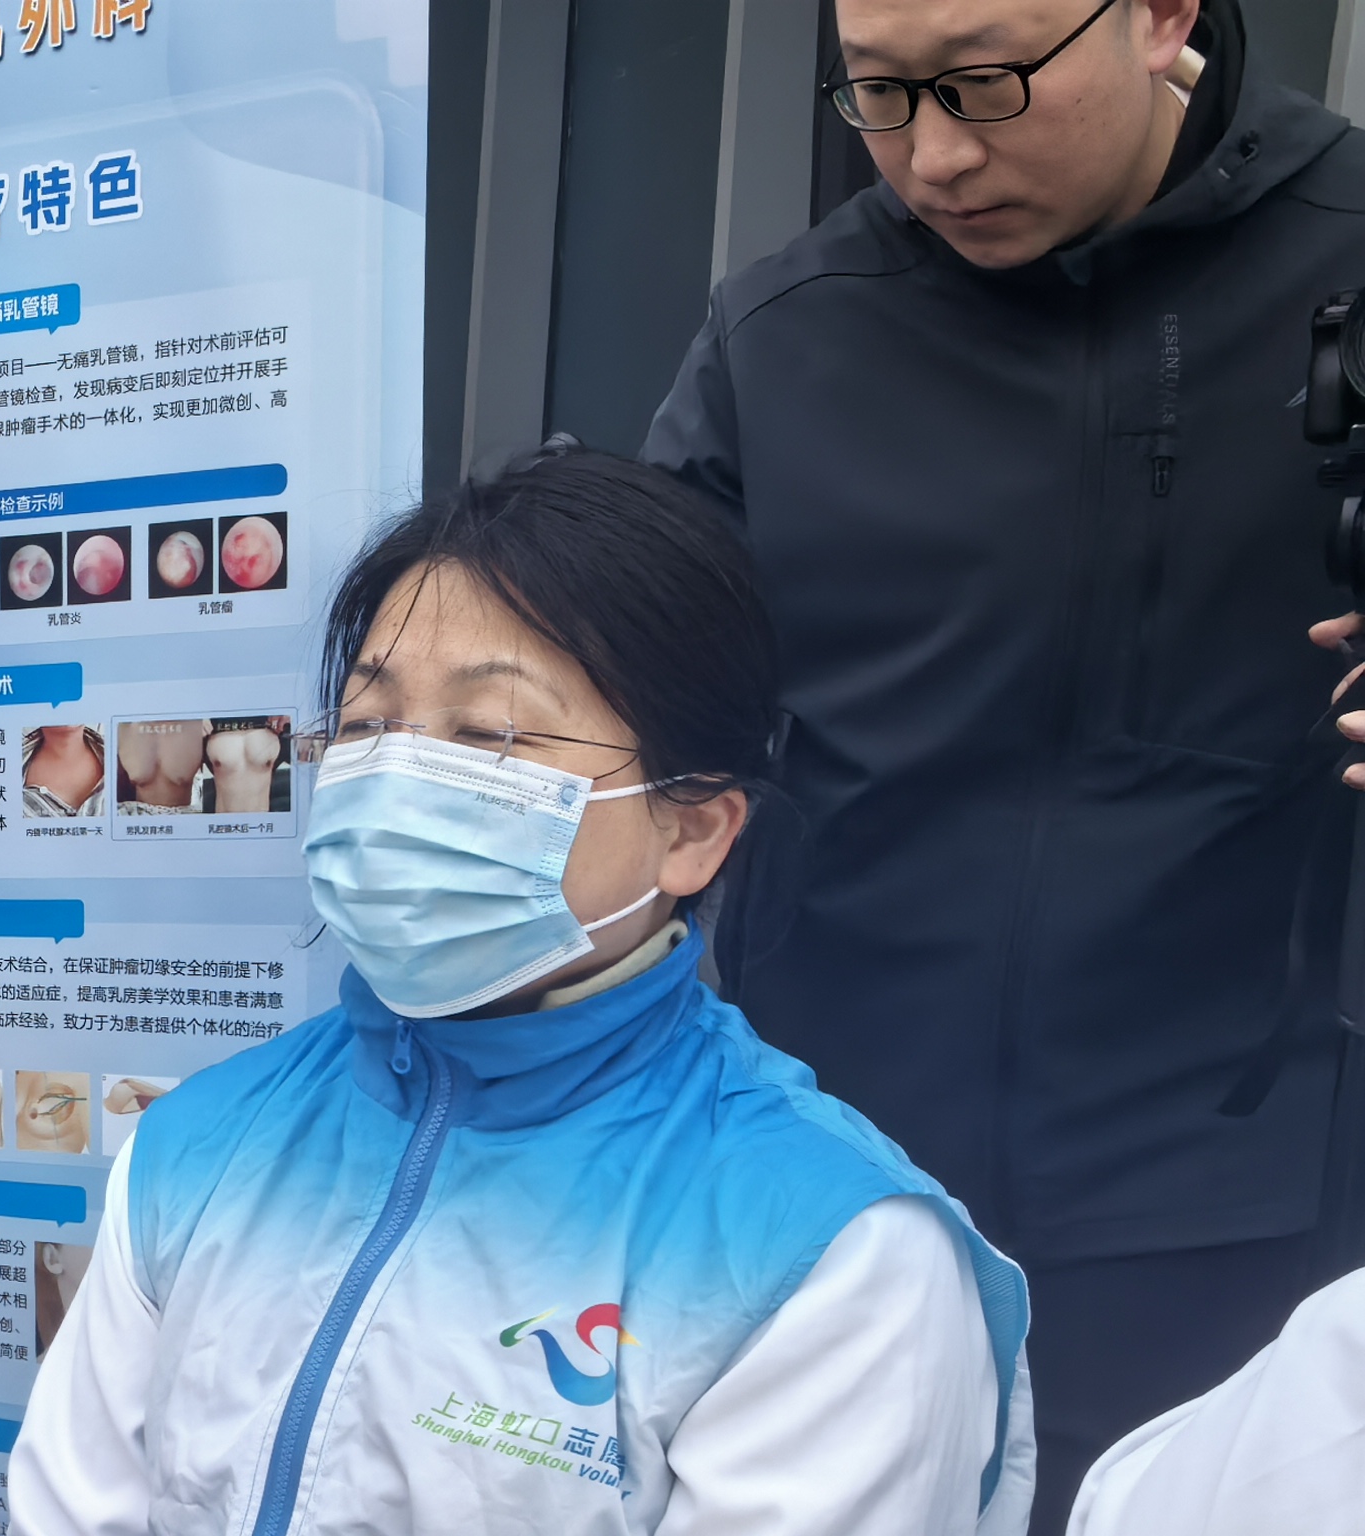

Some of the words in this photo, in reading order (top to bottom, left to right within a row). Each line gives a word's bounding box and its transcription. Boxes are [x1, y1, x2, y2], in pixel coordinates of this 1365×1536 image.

[47, 612, 82, 626] 乳管炎
[412, 1413, 491, 1448] Shanghai
[493, 1439, 574, 1473] Hongkou
